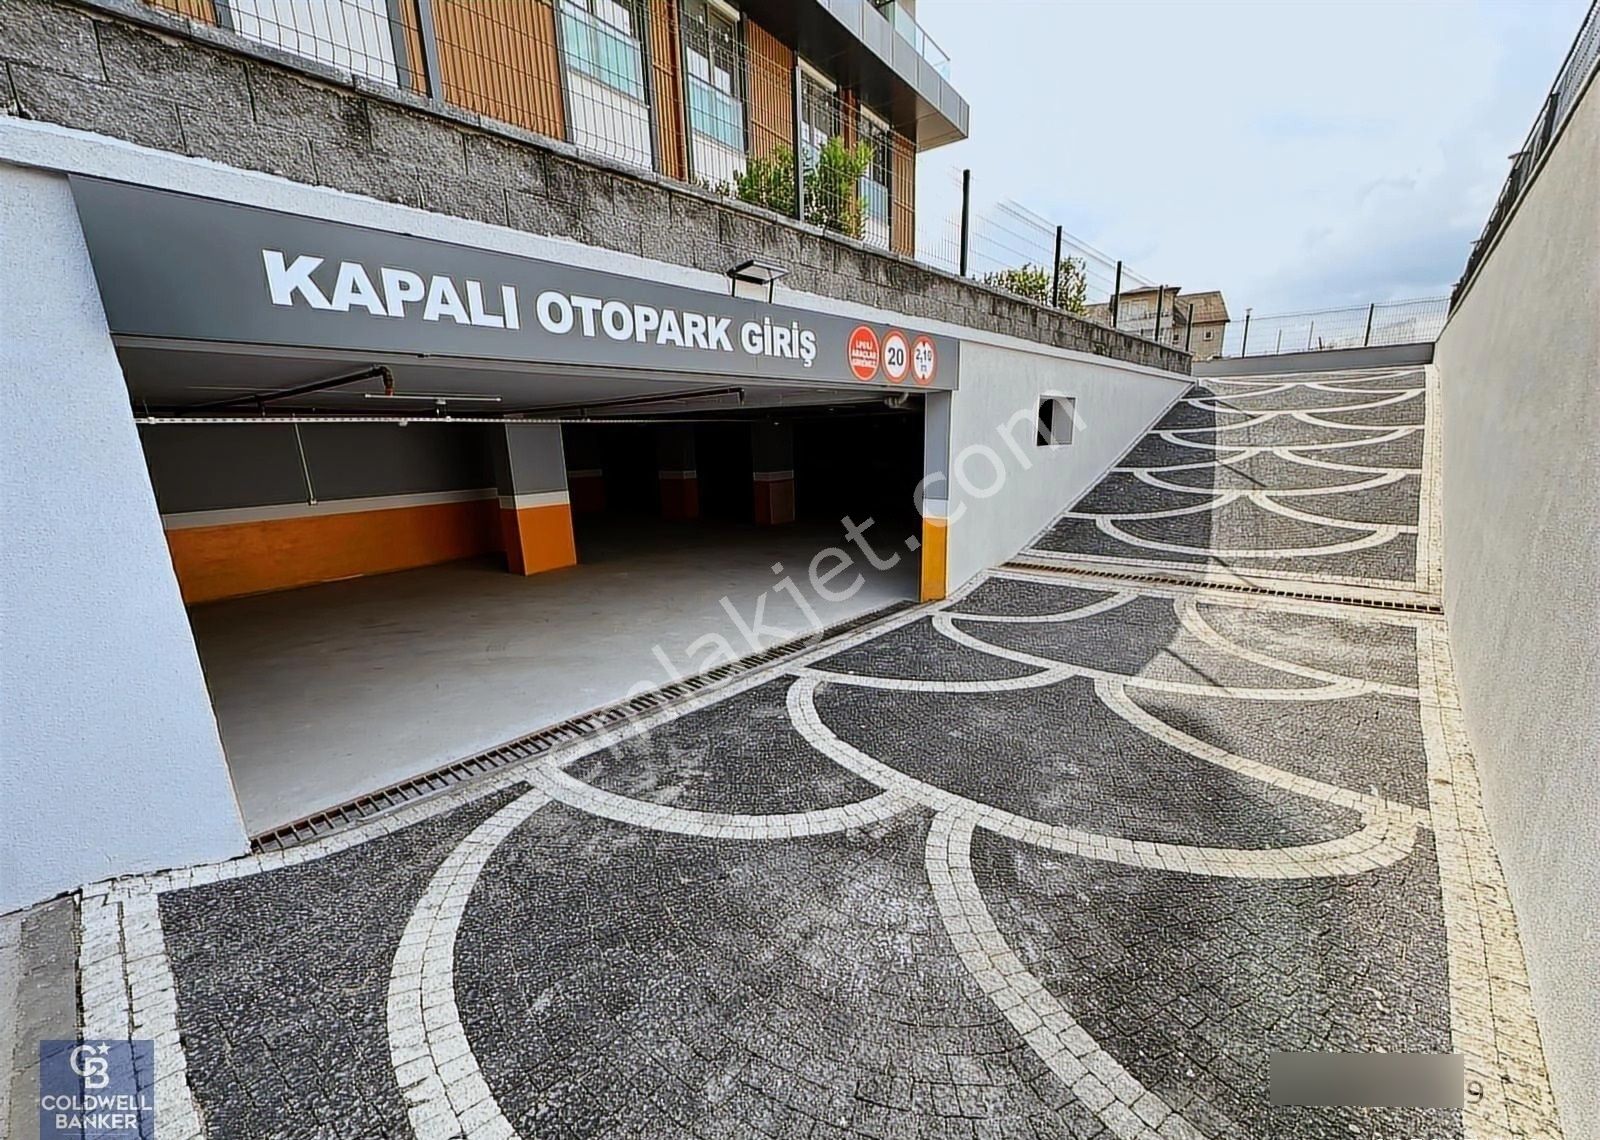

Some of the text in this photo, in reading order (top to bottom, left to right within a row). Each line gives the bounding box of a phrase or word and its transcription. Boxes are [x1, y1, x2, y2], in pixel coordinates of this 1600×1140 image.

[262, 249, 816, 368] KAPALI OTOPARK GİRİŞ
[887, 347, 904, 366] 20
